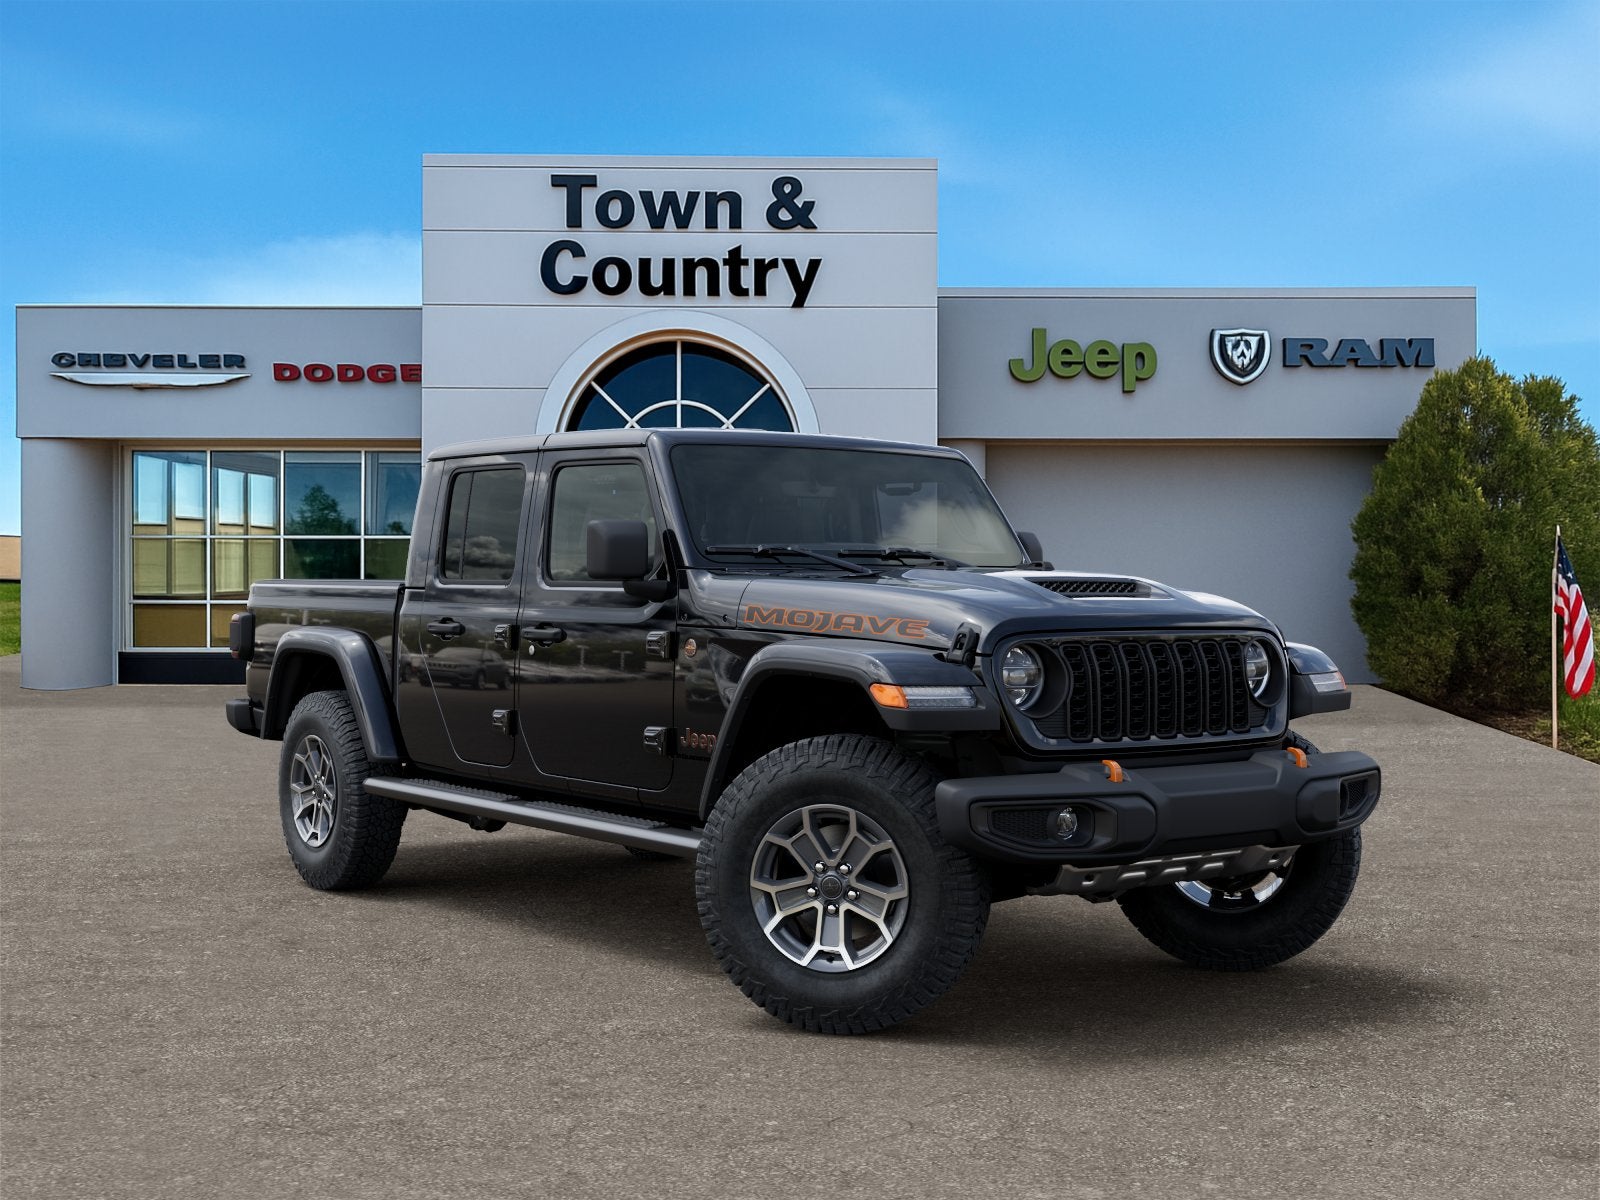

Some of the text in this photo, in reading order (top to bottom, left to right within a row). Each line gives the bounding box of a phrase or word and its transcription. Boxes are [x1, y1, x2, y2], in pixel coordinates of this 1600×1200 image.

[550, 174, 817, 229] Town &
[540, 239, 822, 308] Country
[1008, 328, 1157, 393] Jeep
[1283, 337, 1435, 368] RAM
[273, 363, 422, 383] DODGE
[744, 604, 929, 639] MOJAVE
[680, 727, 718, 753] Jeep
